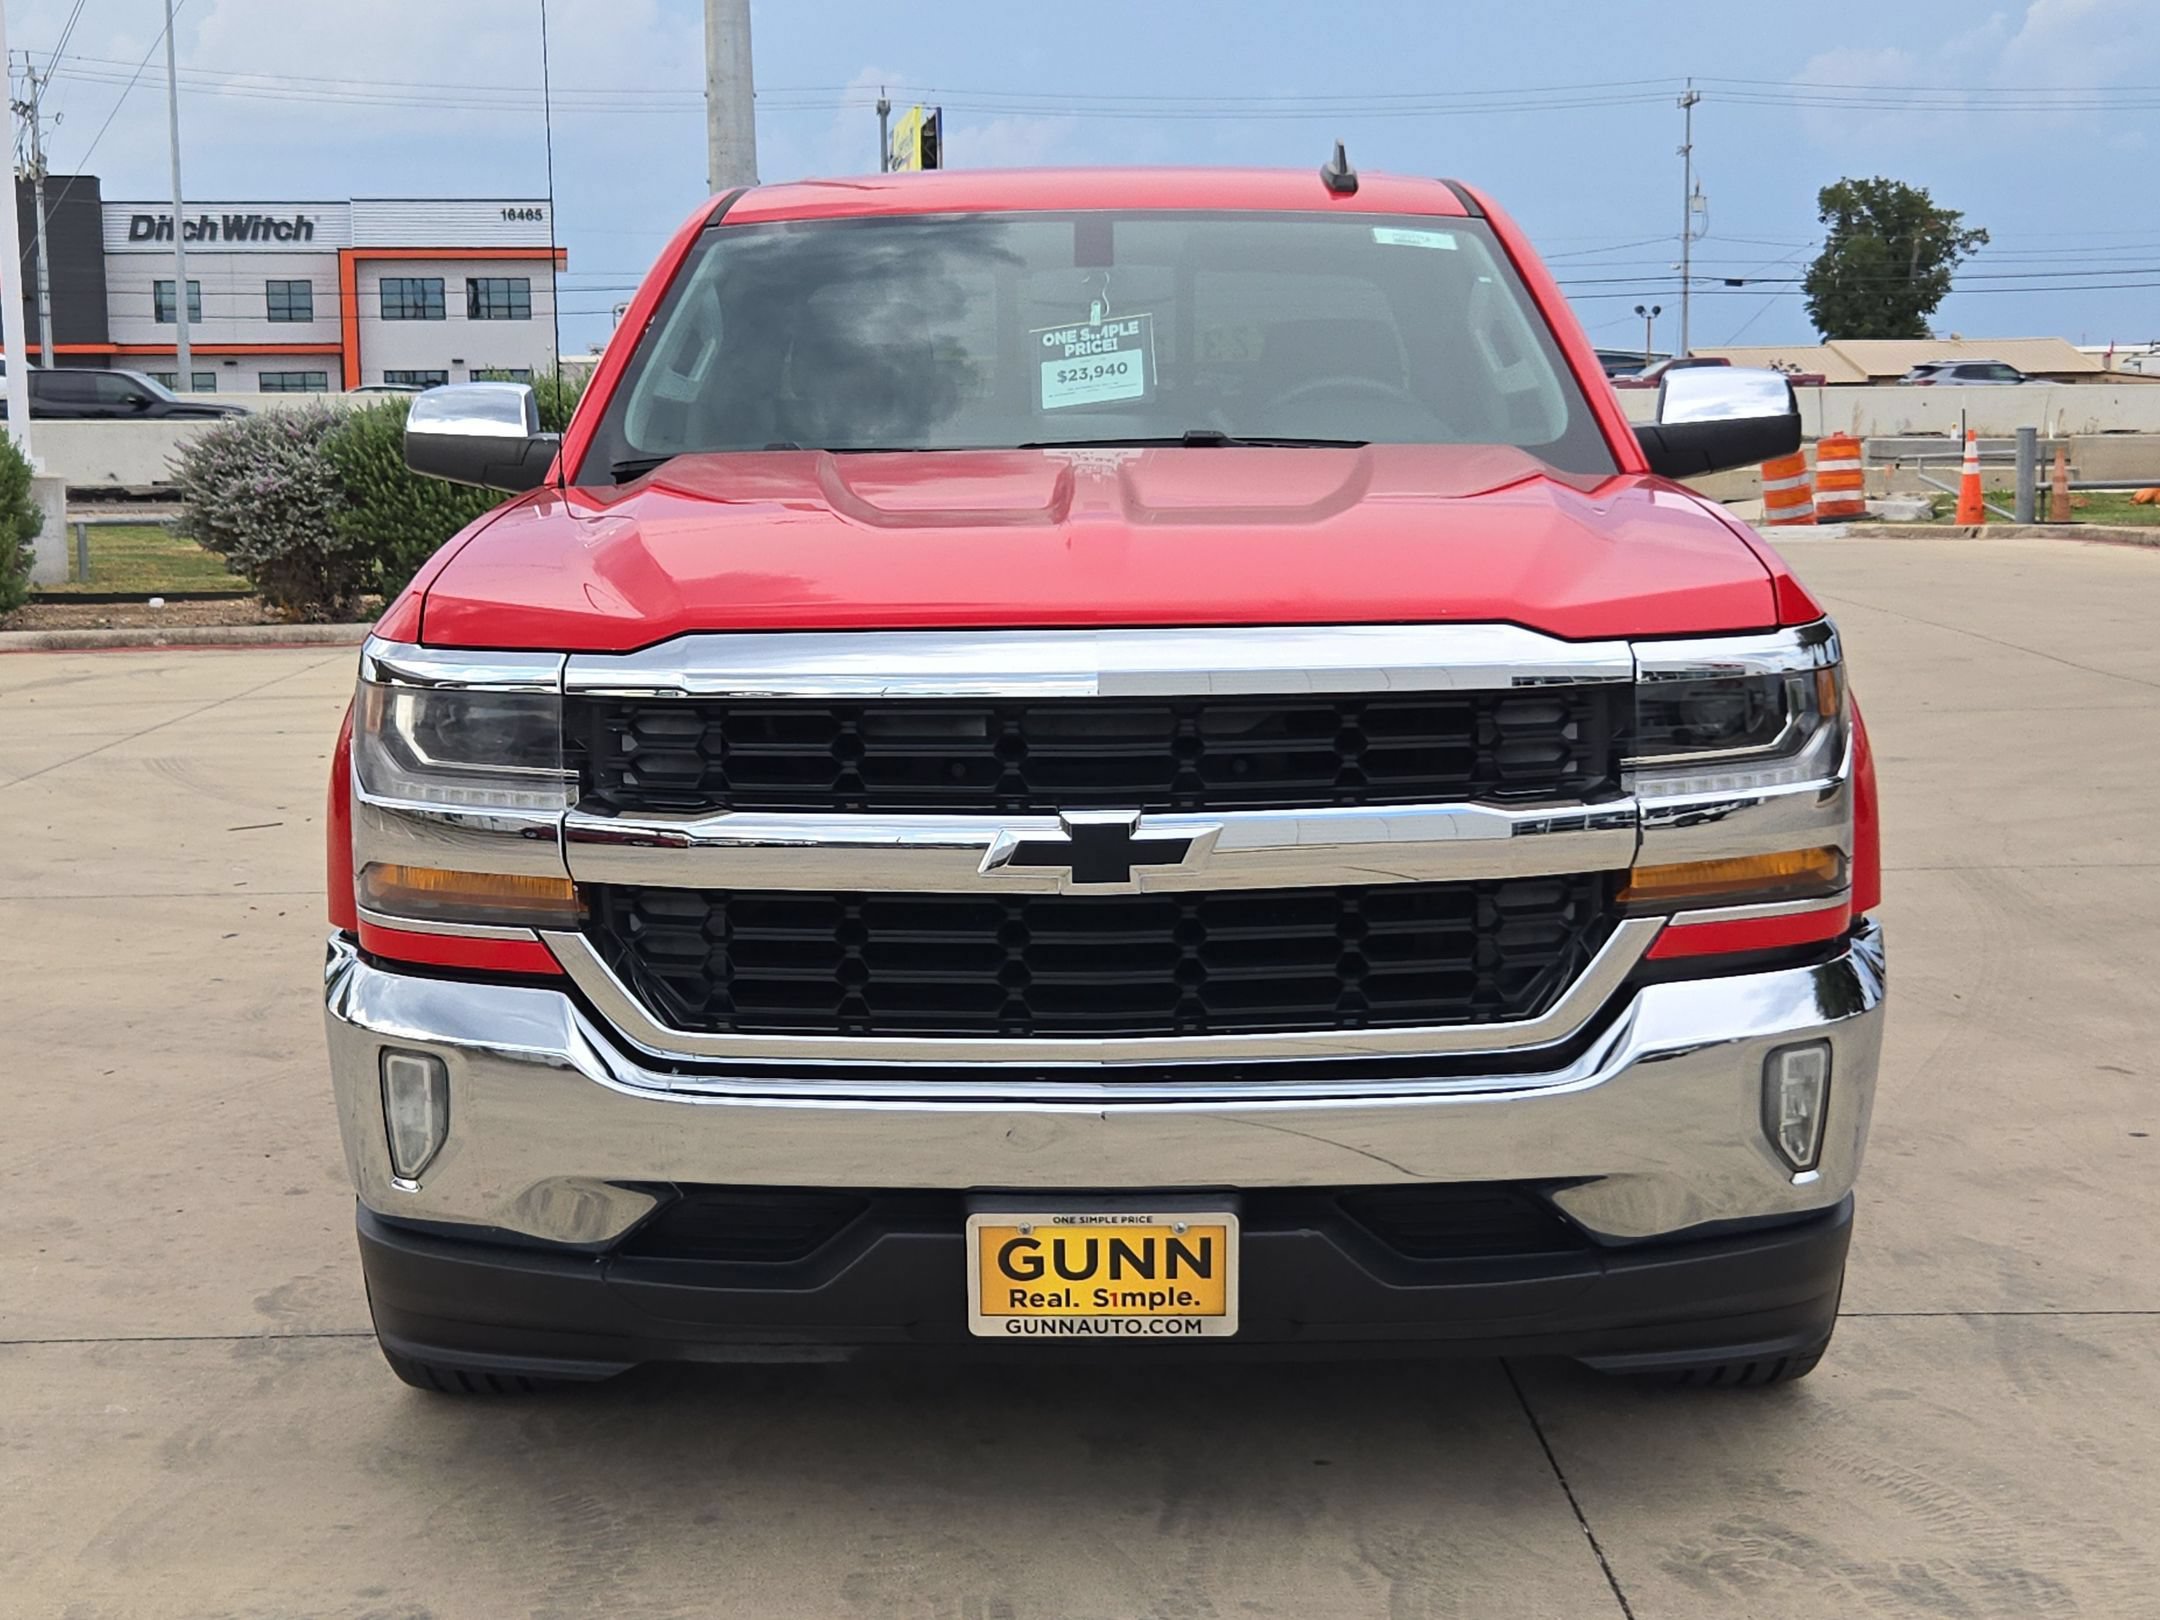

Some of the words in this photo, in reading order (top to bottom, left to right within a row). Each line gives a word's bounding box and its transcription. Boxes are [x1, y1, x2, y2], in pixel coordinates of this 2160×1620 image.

[500, 207, 544, 222] 16465
[221, 214, 315, 242] Witch
[1042, 329, 1078, 347] ONE
[1057, 361, 1128, 384] $23,940
[1053, 1216, 1076, 1224] ONE
[1079, 1216, 1118, 1224] SIMPLE
[1121, 1215, 1153, 1224] PRICE
[997, 1237, 1212, 1281] GUNN
[1009, 1288, 1080, 1308] Real.
[1005, 1318, 1202, 1335] GUNNAUTO.COM
